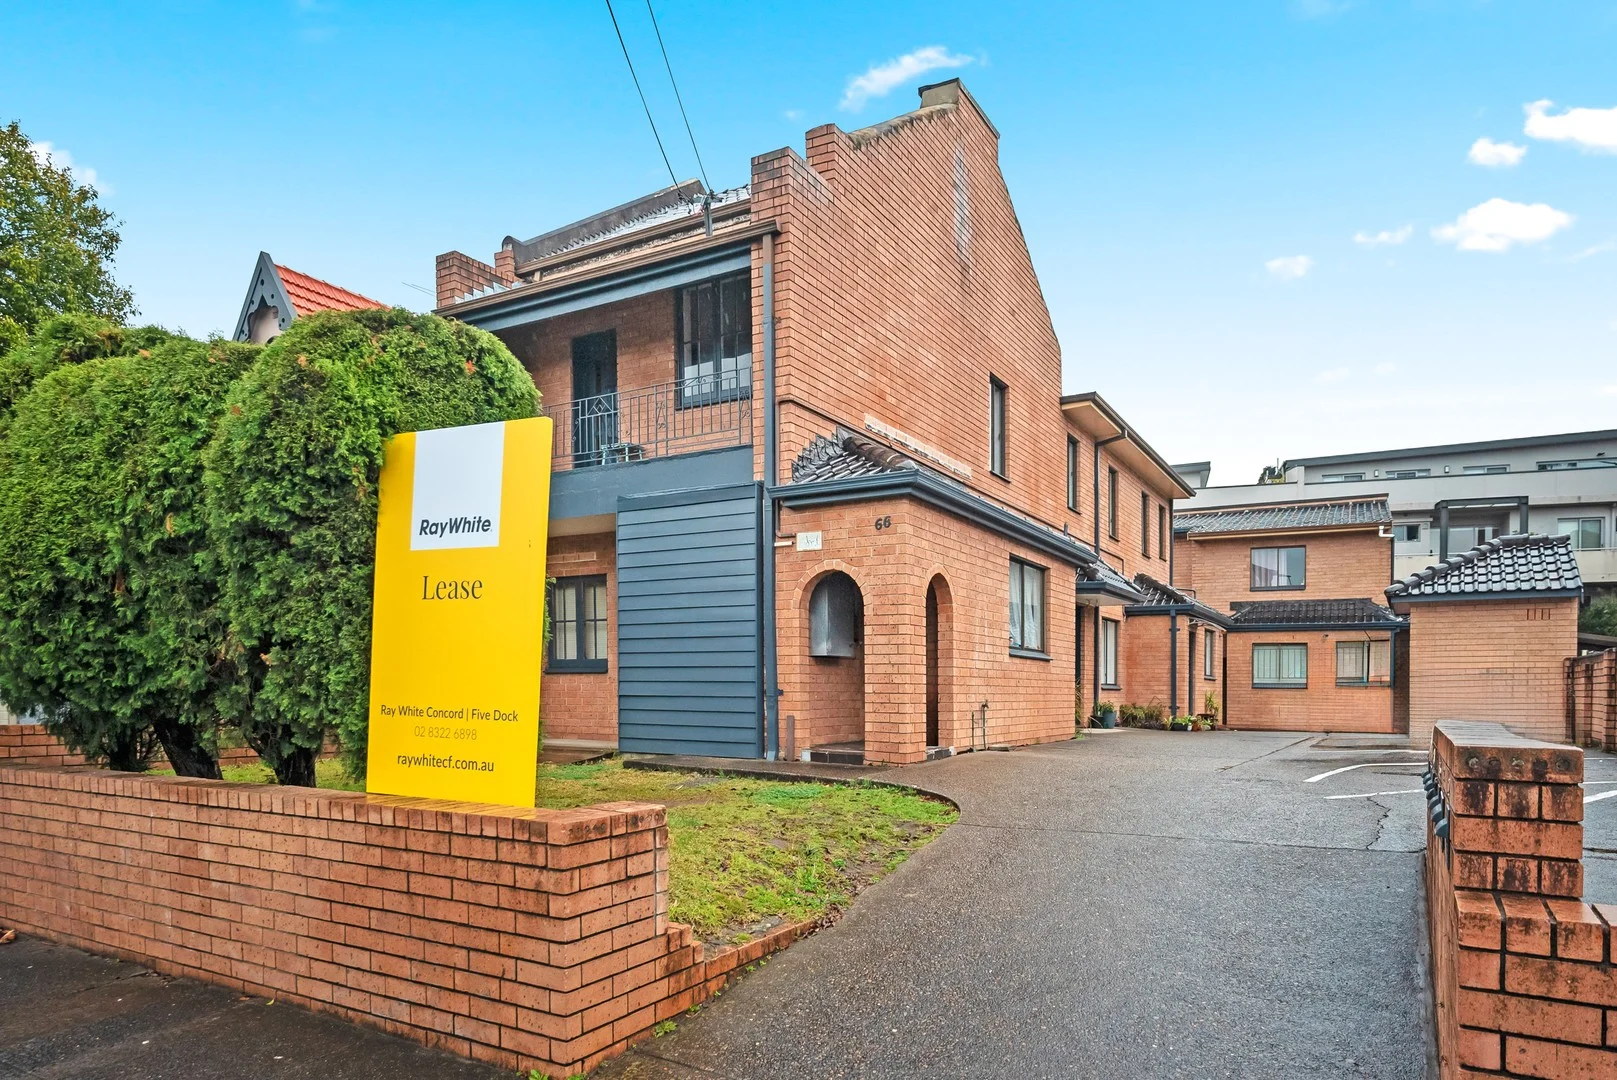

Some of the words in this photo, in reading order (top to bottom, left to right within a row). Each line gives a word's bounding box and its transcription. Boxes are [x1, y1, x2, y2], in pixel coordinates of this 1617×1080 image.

[875, 516, 891, 530] 66
[422, 575, 483, 600] Lease
[380, 704, 396, 718] Ray
[398, 705, 425, 718] White
[426, 706, 464, 720] Concord
[471, 708, 491, 721] Five
[493, 709, 519, 722] Dock
[414, 725, 426, 738] 02
[428, 726, 451, 739] 8322
[453, 728, 478, 741] 6898
[397, 753, 495, 772] raywhitecf.com.au
